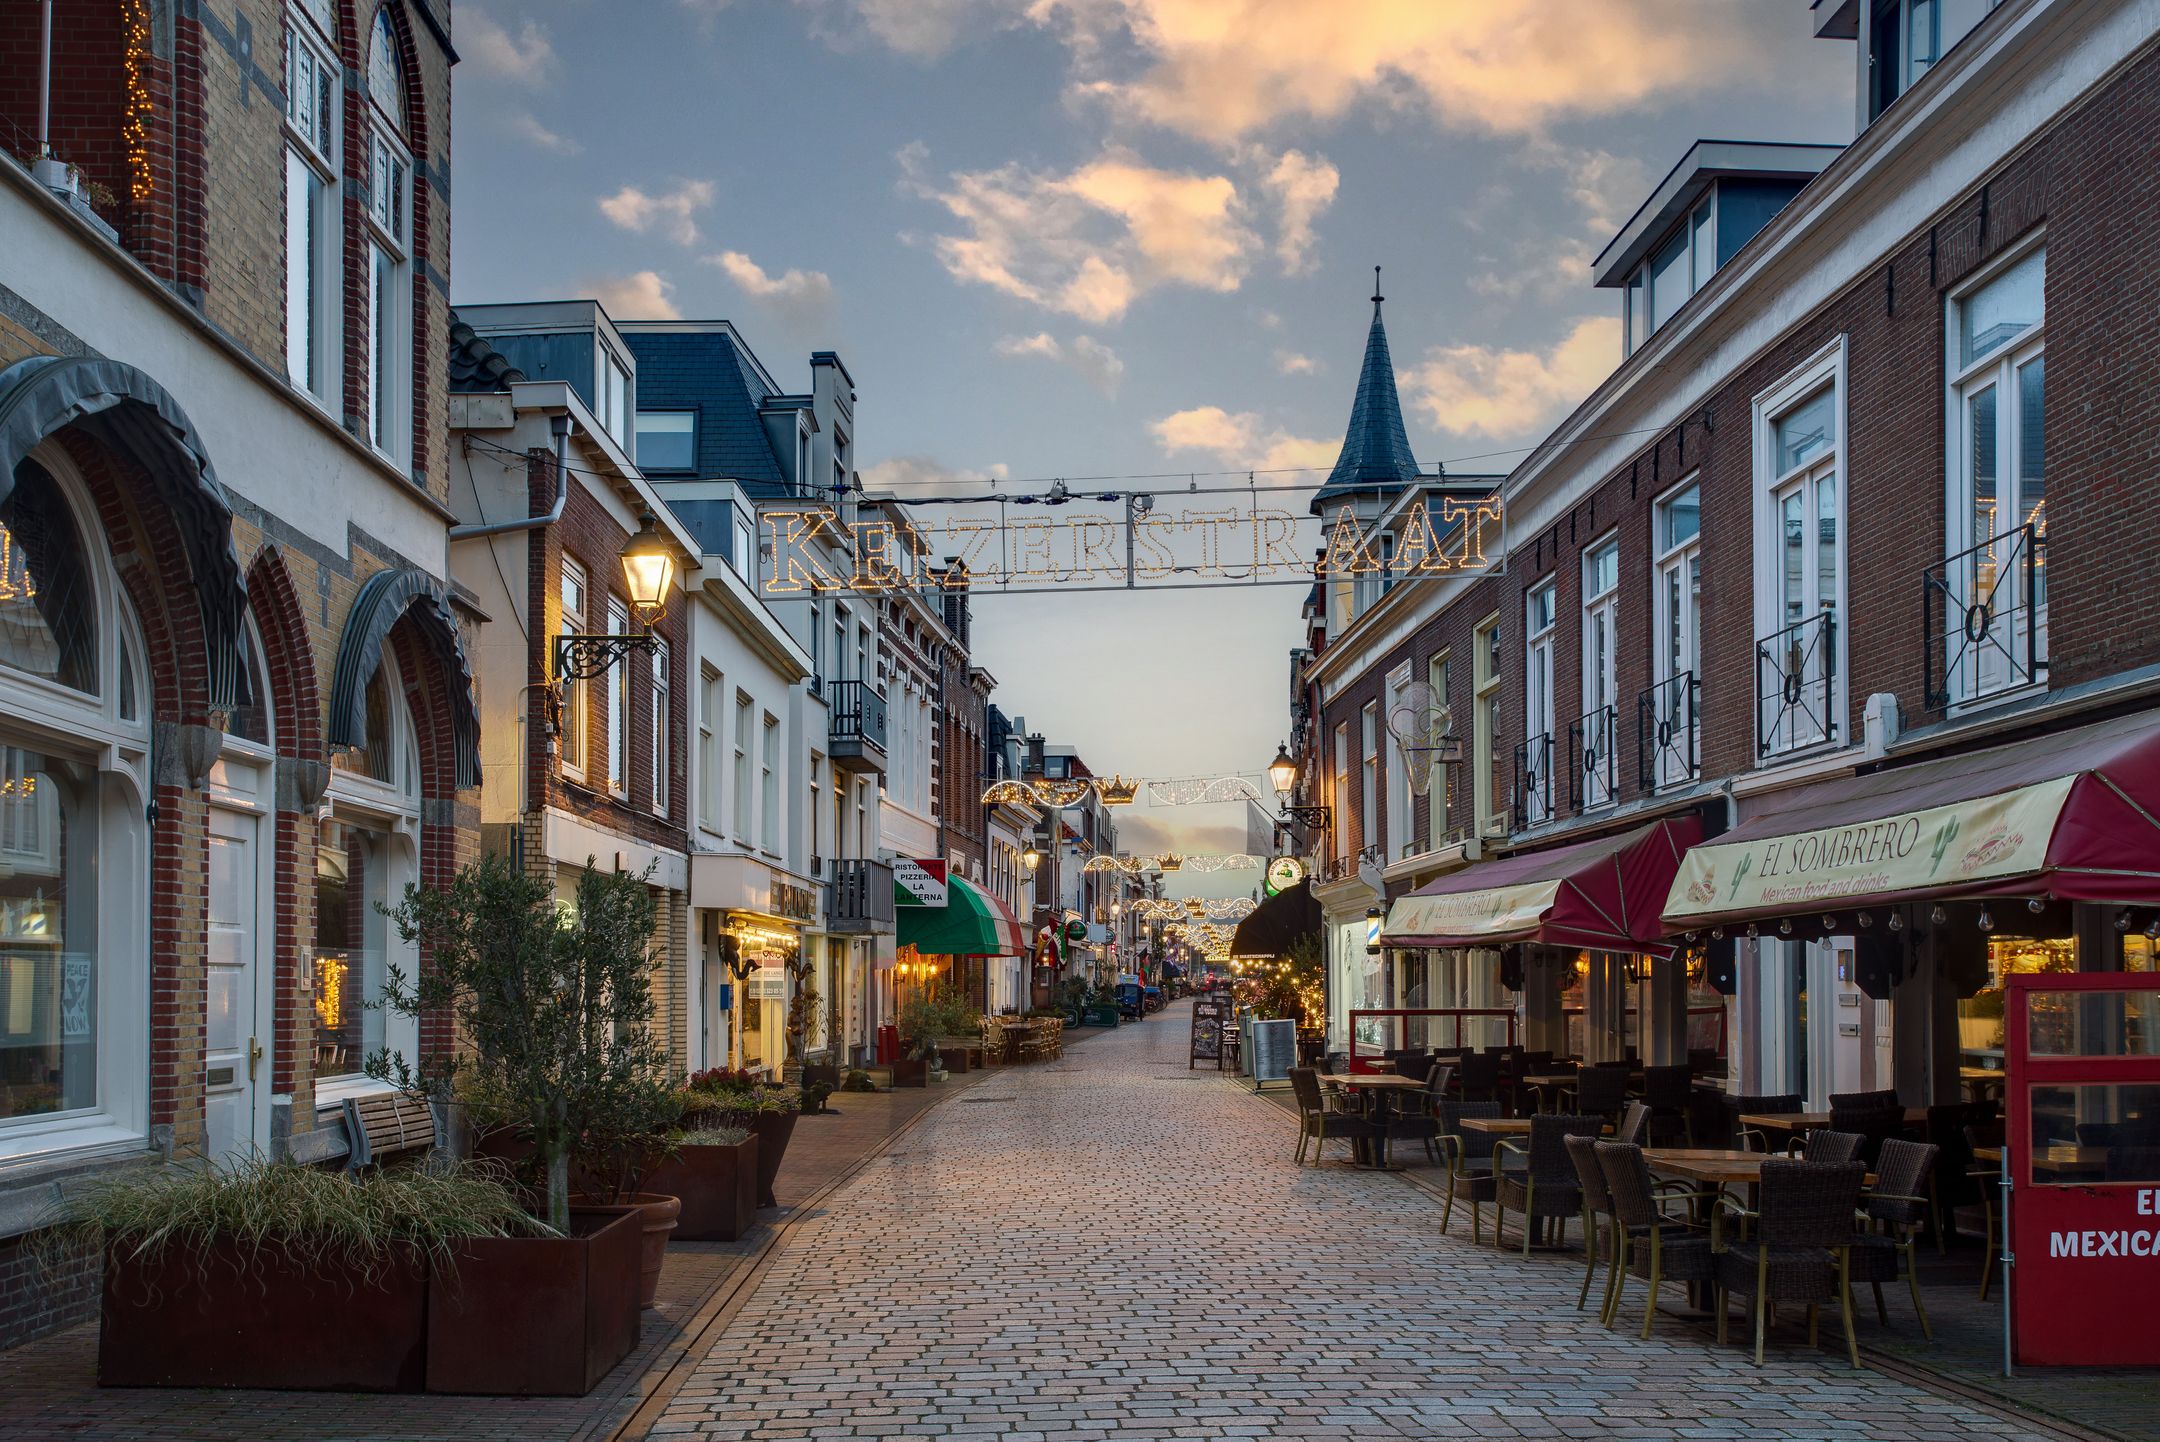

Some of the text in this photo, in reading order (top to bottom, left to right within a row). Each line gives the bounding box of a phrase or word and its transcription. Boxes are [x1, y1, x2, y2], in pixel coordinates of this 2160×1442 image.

[763, 496, 1501, 592] KEIZERSTRAAT
[1760, 817, 1920, 878] EL SOMBRERO
[894, 893, 943, 901] LANTERNA
[1760, 871, 1890, 902] Mexican food and drinks
[66, 964, 88, 977] PEACE
[65, 1015, 86, 1032] NOW
